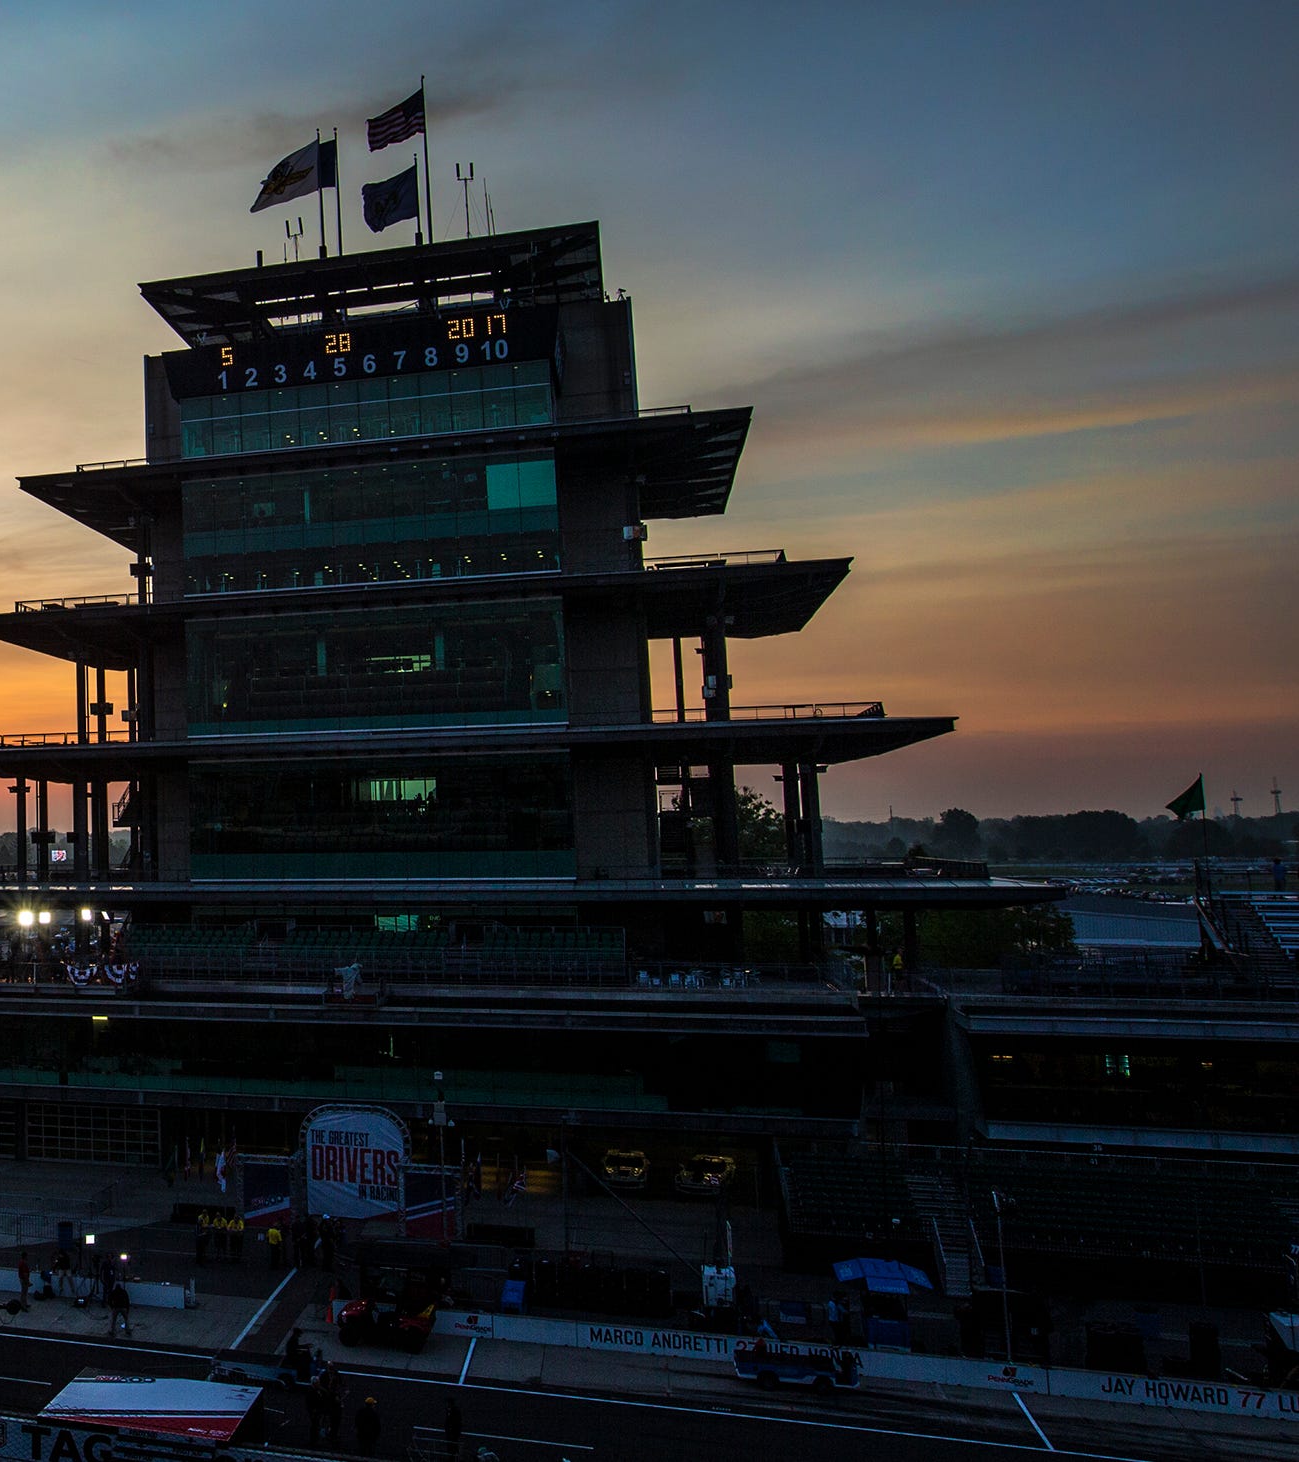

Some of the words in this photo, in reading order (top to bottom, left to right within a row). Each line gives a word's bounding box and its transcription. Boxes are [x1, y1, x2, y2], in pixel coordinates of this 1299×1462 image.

[218, 370, 228, 390] 1
[245, 367, 259, 388] 2
[274, 364, 288, 384] 3
[303, 360, 317, 380] 4
[334, 357, 347, 377] 5
[363, 353, 377, 374] 6
[393, 350, 407, 370] 7
[424, 346, 439, 367] 8
[455, 343, 469, 364] 9
[480, 338, 509, 361] 10
[221, 346, 234, 367] 5
[324, 333, 351, 354] 28
[310, 1129, 326, 1145] THE
[328, 1131, 370, 1148] GREATEST
[311, 1144, 400, 1187] DRIVERS
[358, 1185, 367, 1200] IN
[589, 1327, 645, 1347] MARCO
[651, 1331, 729, 1354] ANDRETTI
[1102, 1376, 1135, 1396] JAY
[1145, 1381, 1229, 1406] HOWARD
[1237, 1390, 1266, 1410] 77
[21, 1425, 113, 1462] TAG
